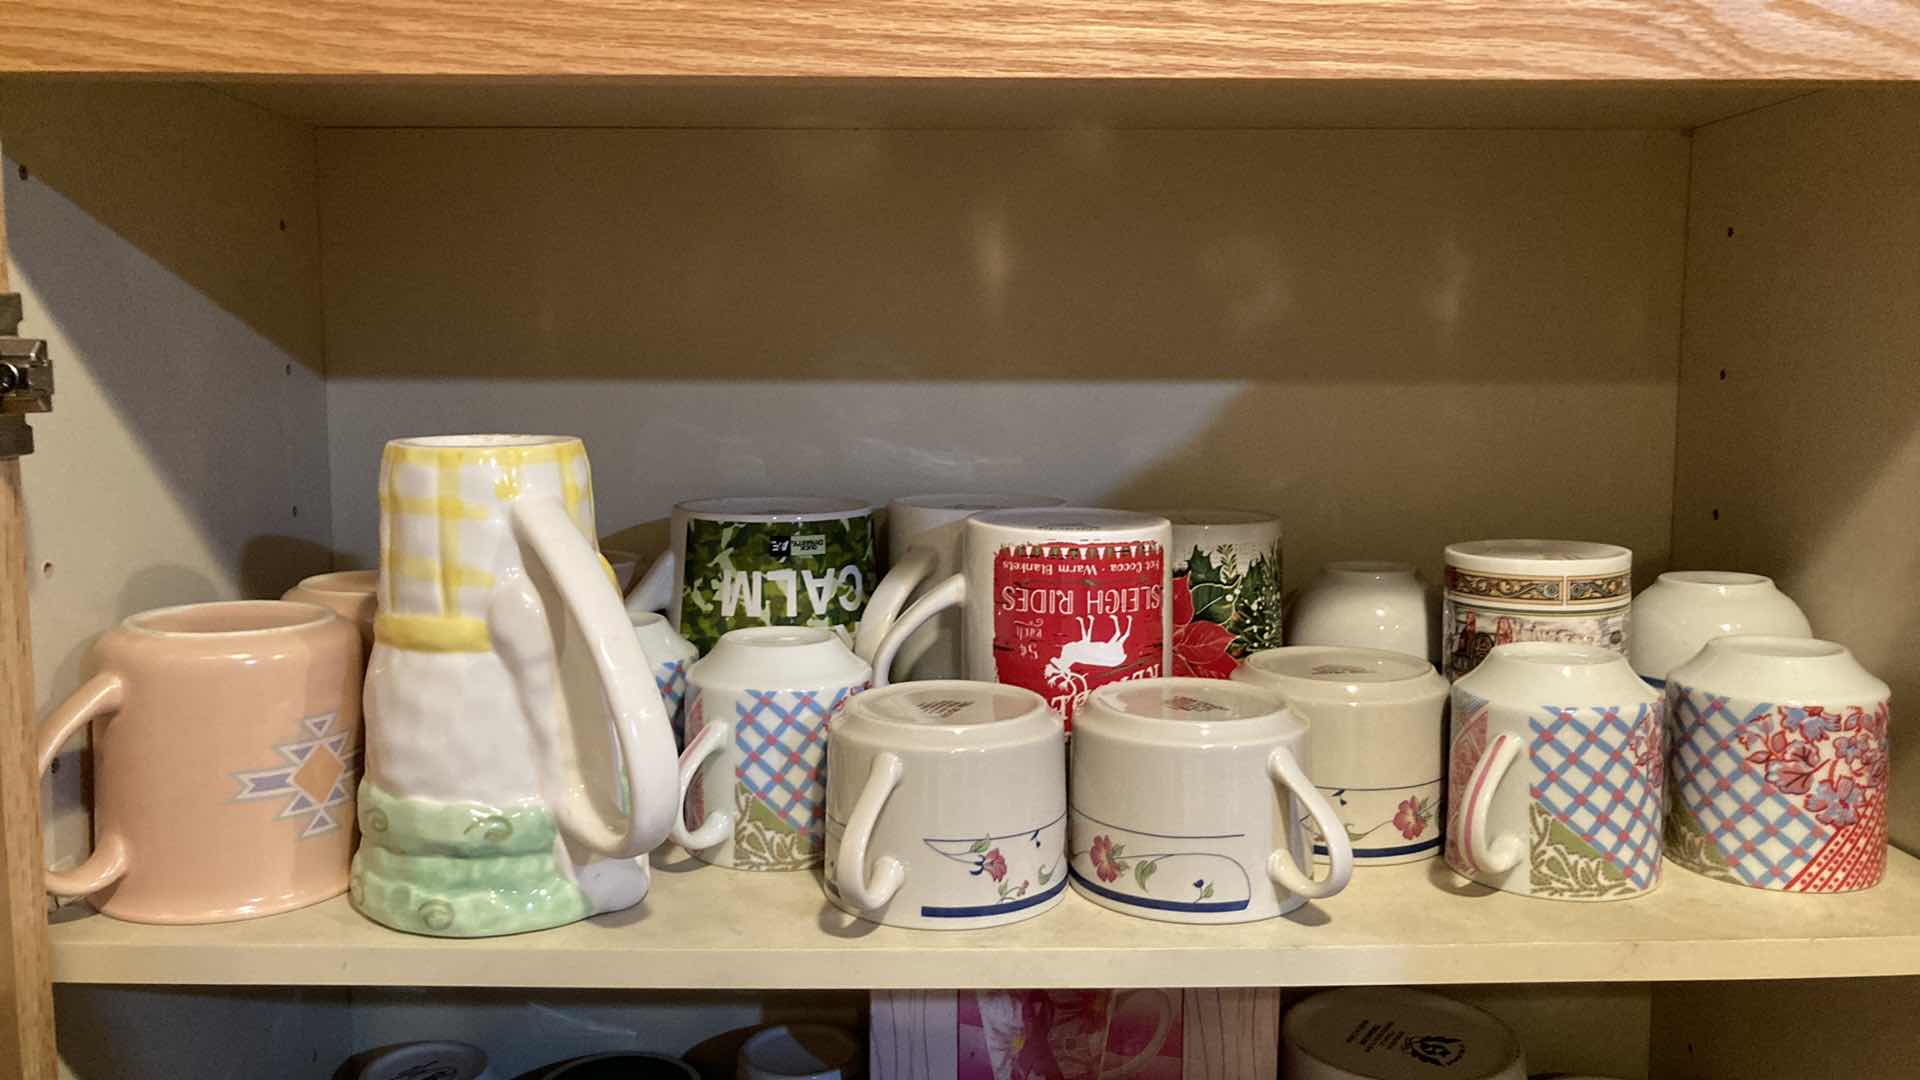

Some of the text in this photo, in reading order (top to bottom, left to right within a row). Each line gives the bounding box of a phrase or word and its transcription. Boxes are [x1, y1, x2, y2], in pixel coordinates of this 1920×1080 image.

[1002, 560, 1053, 576] Blankets
[1058, 564, 1098, 576] Warm
[1110, 562, 1143, 574] Cocoa
[719, 565, 863, 618] CALM
[1002, 586, 1161, 615] SLEIGH RIDES
